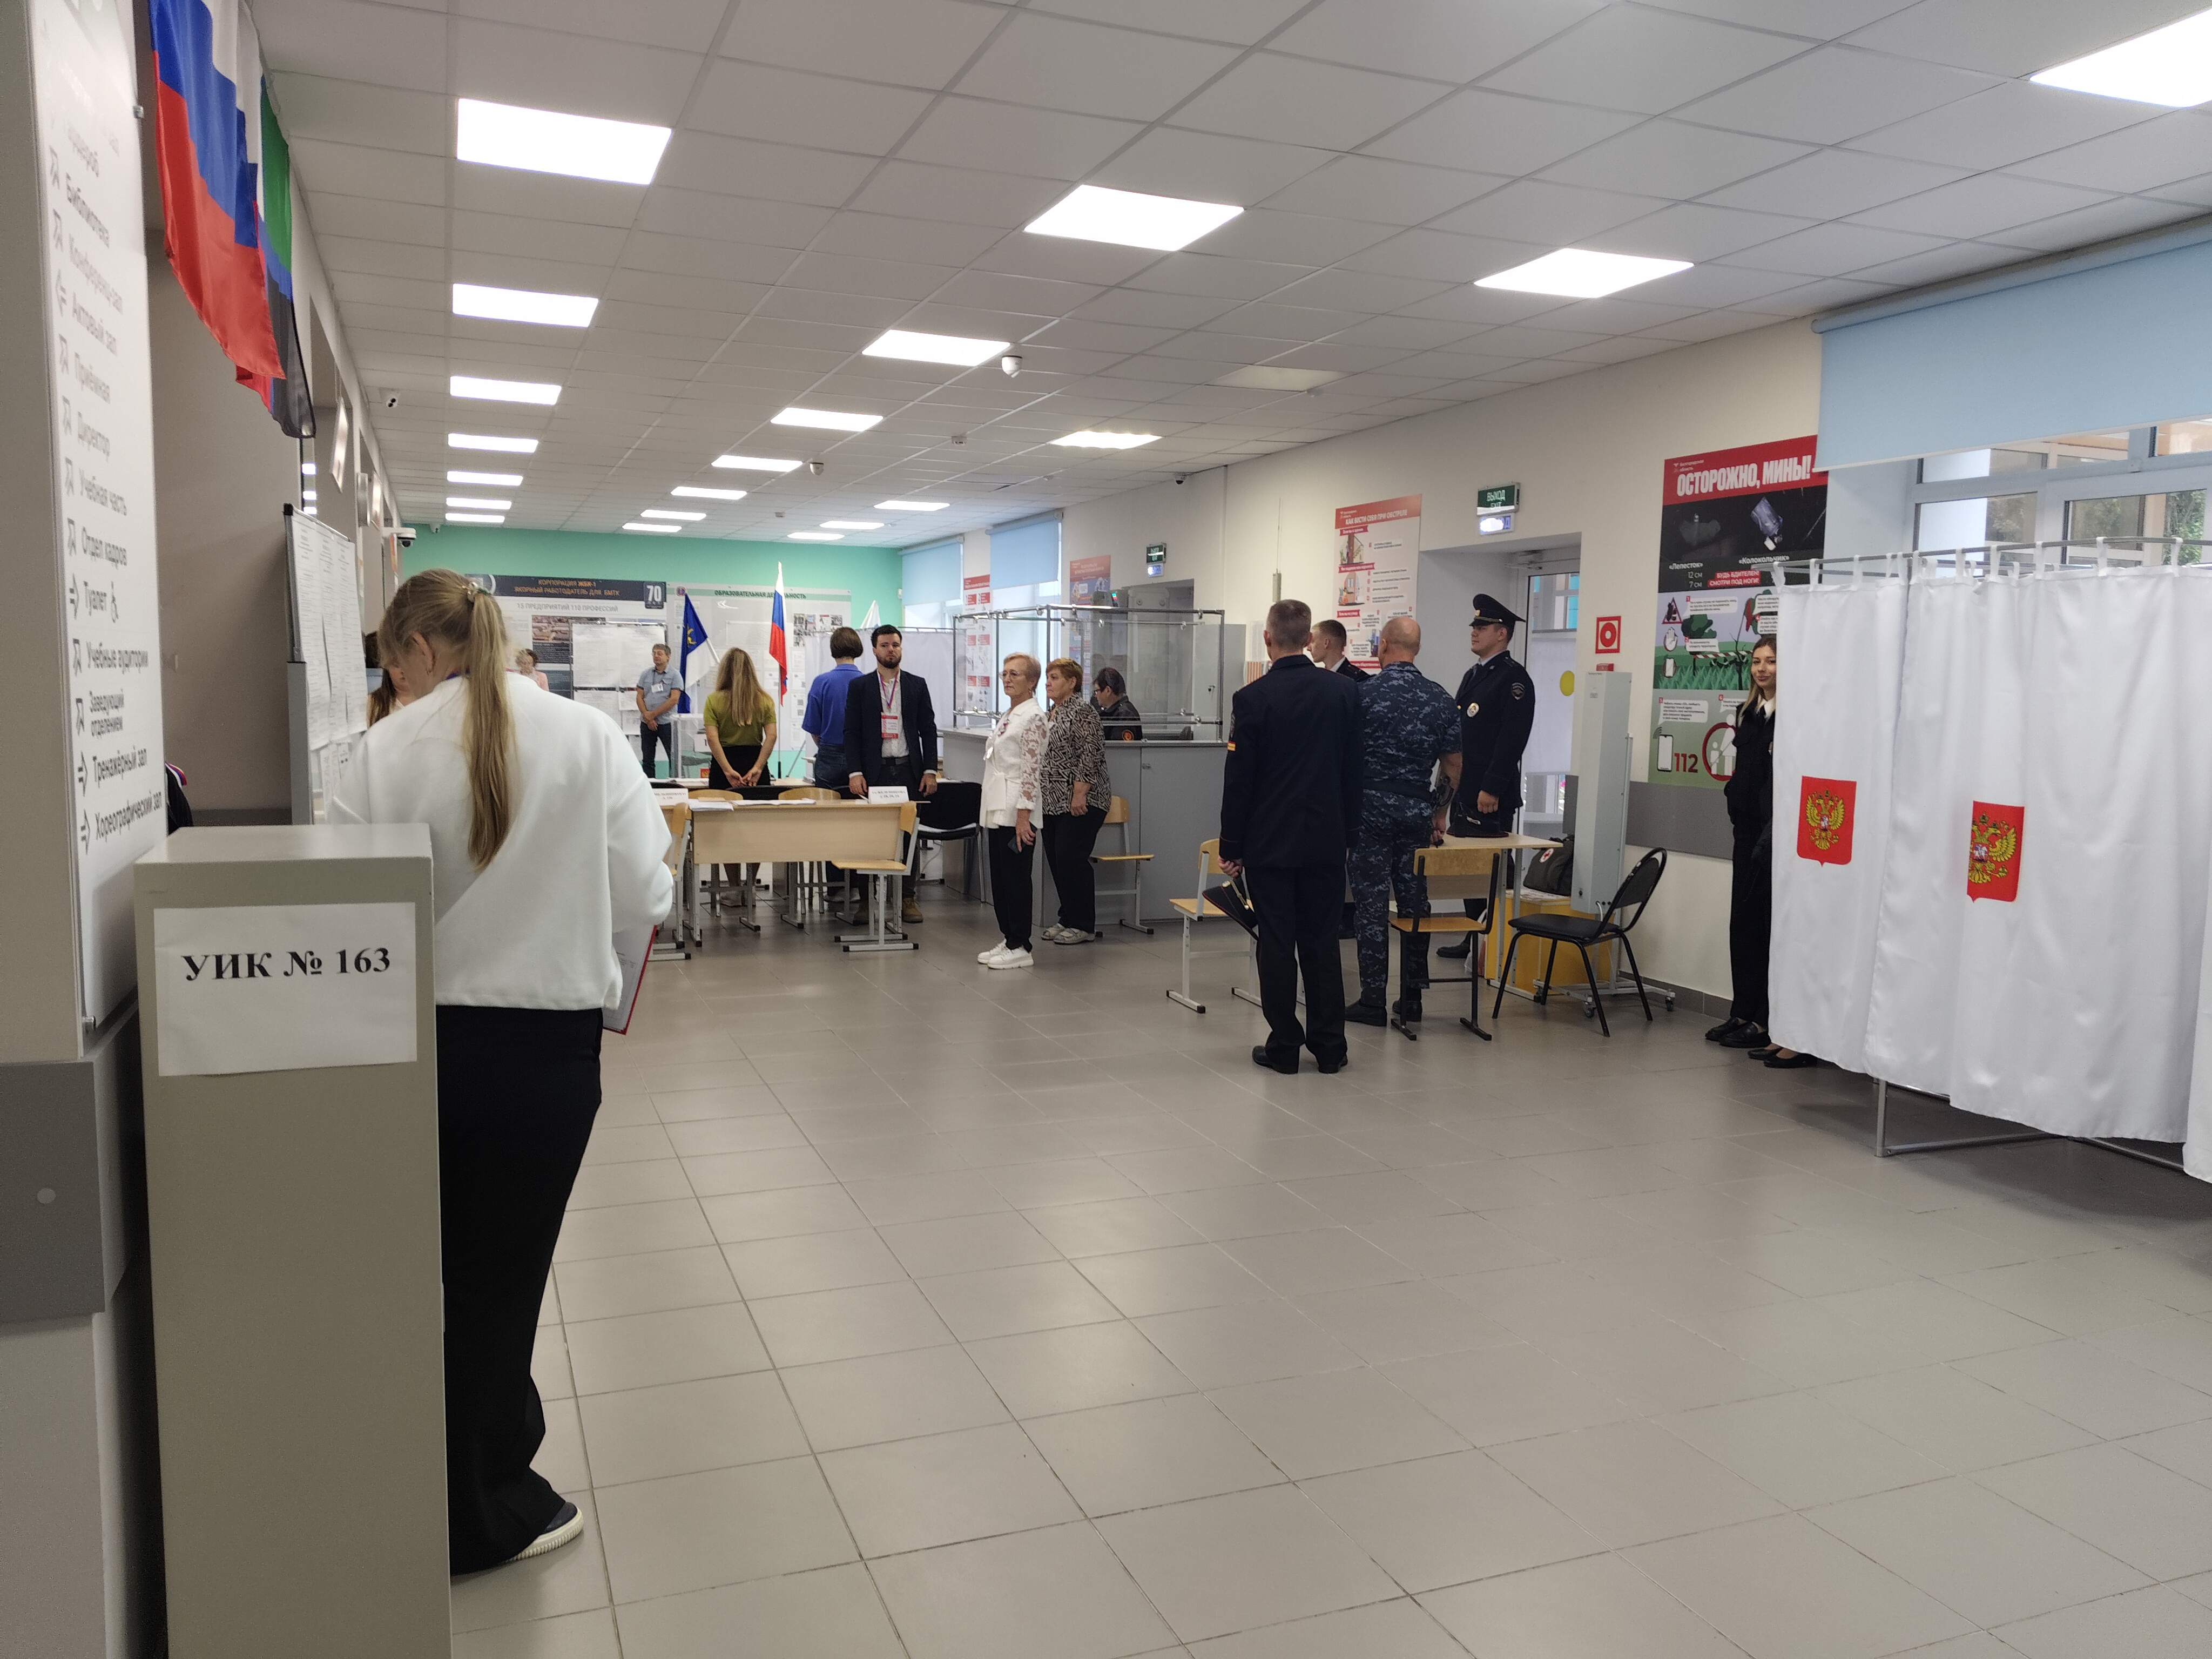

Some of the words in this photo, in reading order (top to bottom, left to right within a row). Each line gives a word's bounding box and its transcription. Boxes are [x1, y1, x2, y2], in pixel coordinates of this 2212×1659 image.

[1677, 463, 1760, 496] ОСТОРОЖНО,
[1762, 455, 1812, 485] МИНЫ!
[1487, 489, 1505, 502] ВЫХОД
[82, 526, 104, 561] Отдел
[105, 542, 127, 569] кадров
[1738, 556, 1790, 564] «Колокольчик»
[83, 581, 107, 616] Туалет
[646, 585, 662, 602] 70
[86, 640, 117, 669] Учебные
[89, 689, 124, 716] Заведующий
[92, 745, 137, 788] Тренажёрный
[137, 747, 147, 768] зал
[1674, 753, 1698, 773] 112
[95, 790, 152, 843] Хореографический
[152, 790, 163, 812] зал
[180, 952, 272, 981] УИК
[283, 949, 322, 977] №
[335, 947, 390, 974] 163
